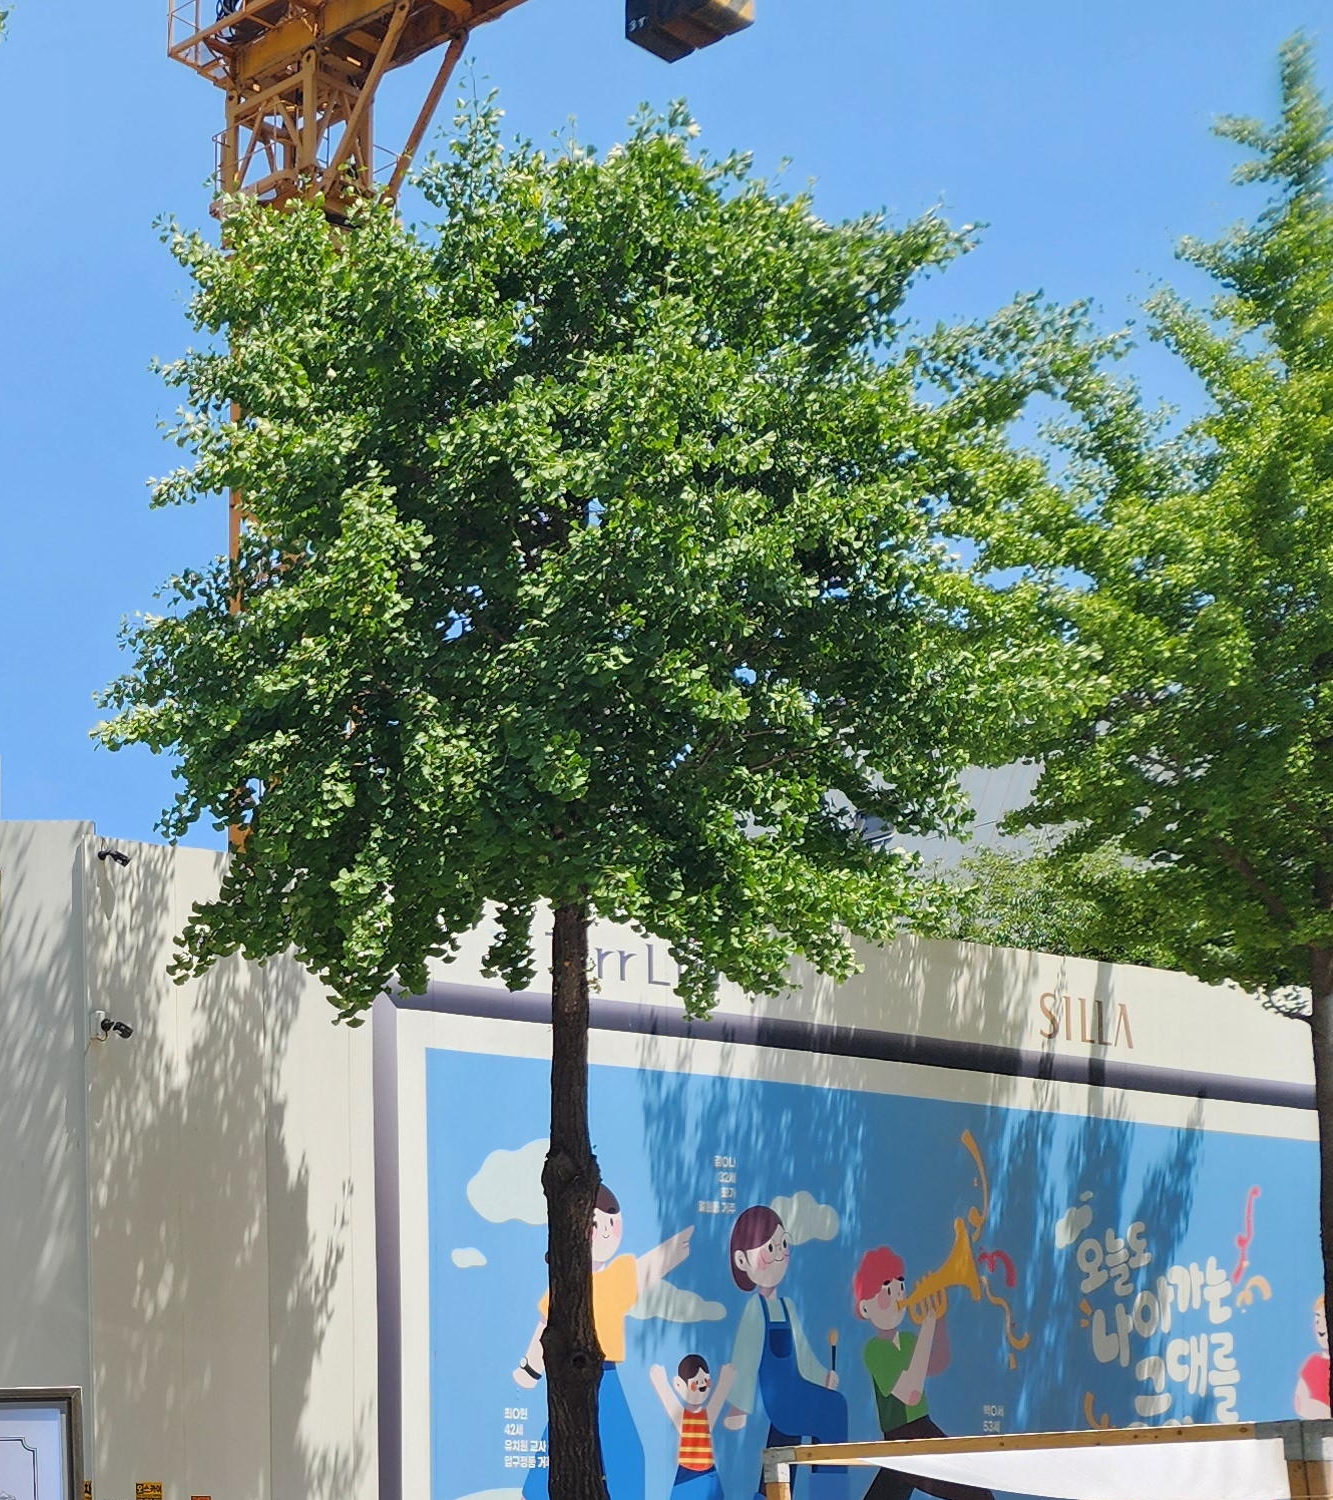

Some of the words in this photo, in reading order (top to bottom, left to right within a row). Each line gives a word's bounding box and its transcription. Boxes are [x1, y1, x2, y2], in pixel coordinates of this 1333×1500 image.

[1039, 992, 1134, 1049] SILLA
[1076, 1220, 1152, 1297] 오늘도
[1091, 1255, 1233, 1368] 나아가는
[1134, 1331, 1241, 1424] 그대를
[504, 1423, 524, 1436] 42세
[530, 1440, 547, 1453] 교사
